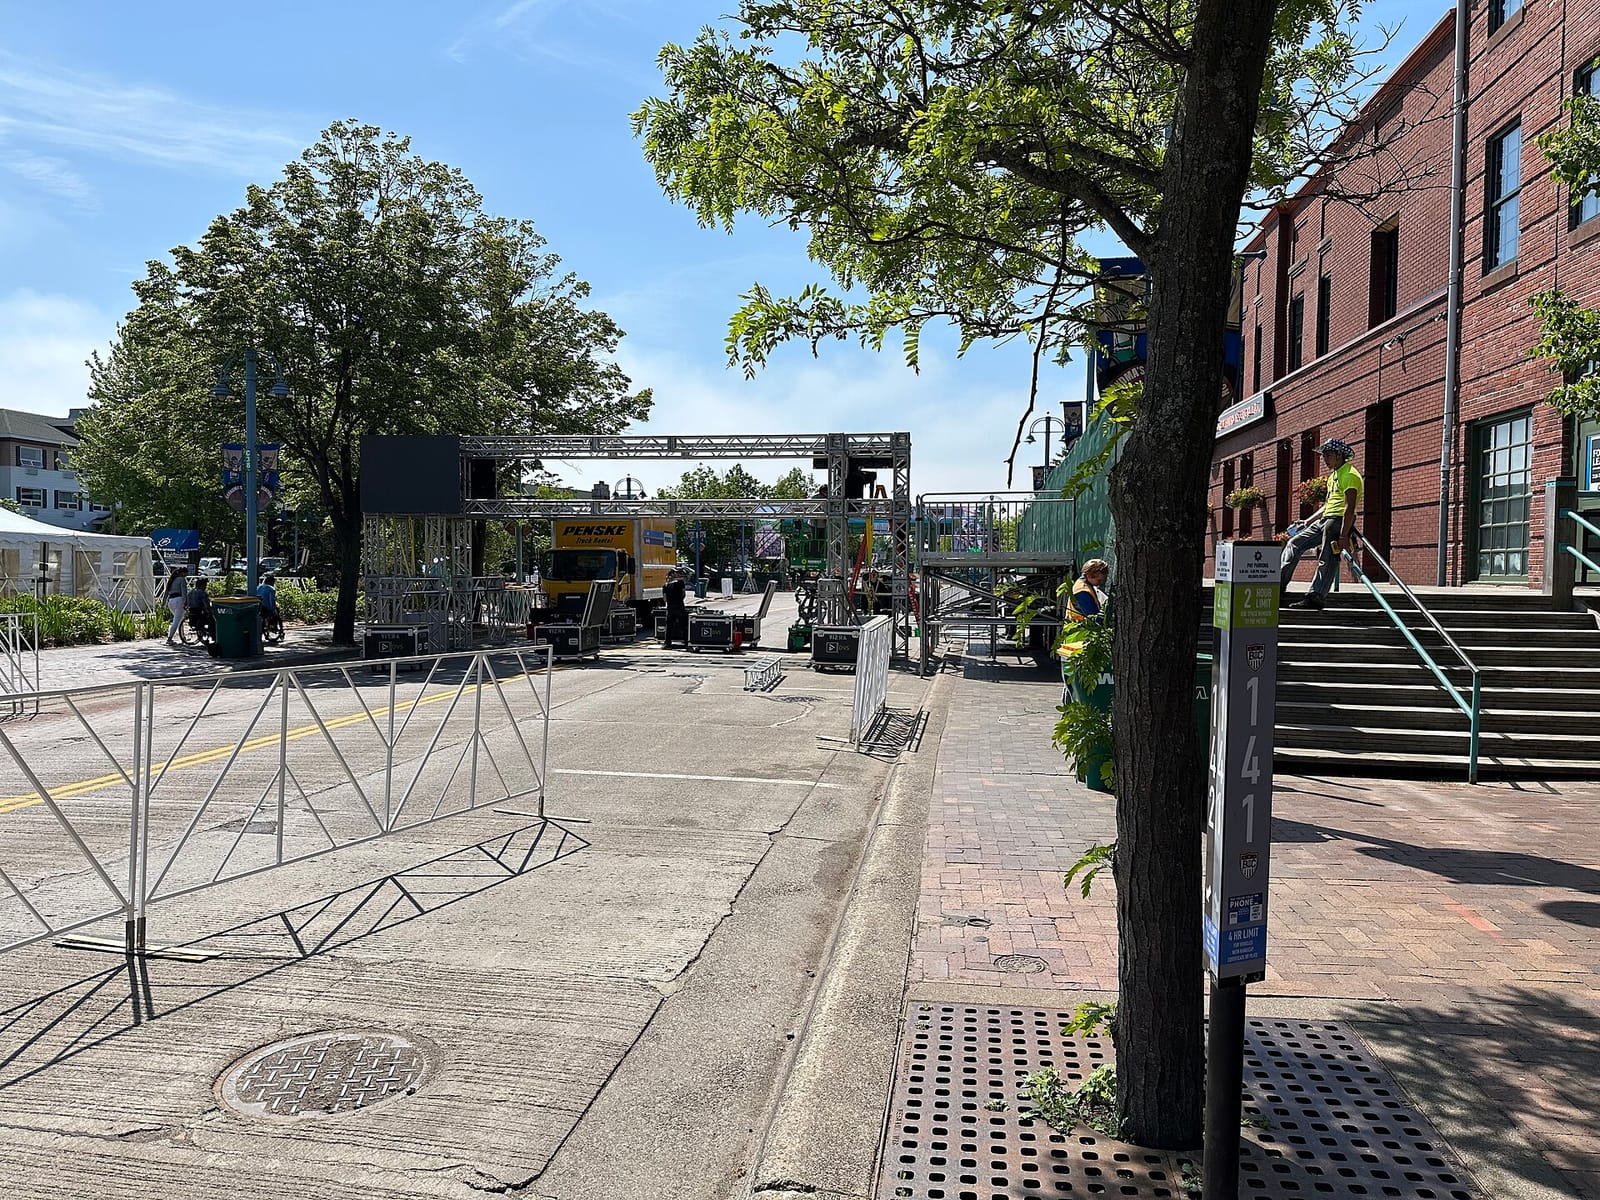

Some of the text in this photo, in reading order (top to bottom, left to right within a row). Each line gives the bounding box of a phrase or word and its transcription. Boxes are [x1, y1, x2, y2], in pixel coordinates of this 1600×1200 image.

[562, 525, 627, 536] PENSKE
[1244, 588, 1251, 608] 2
[1256, 588, 1272, 597] HOUR
[1256, 599, 1271, 608] LIMIT
[1240, 676, 1261, 843] 141
[1230, 898, 1254, 909] PHONE
[1228, 928, 1259, 941] 4 HR LIMIT
